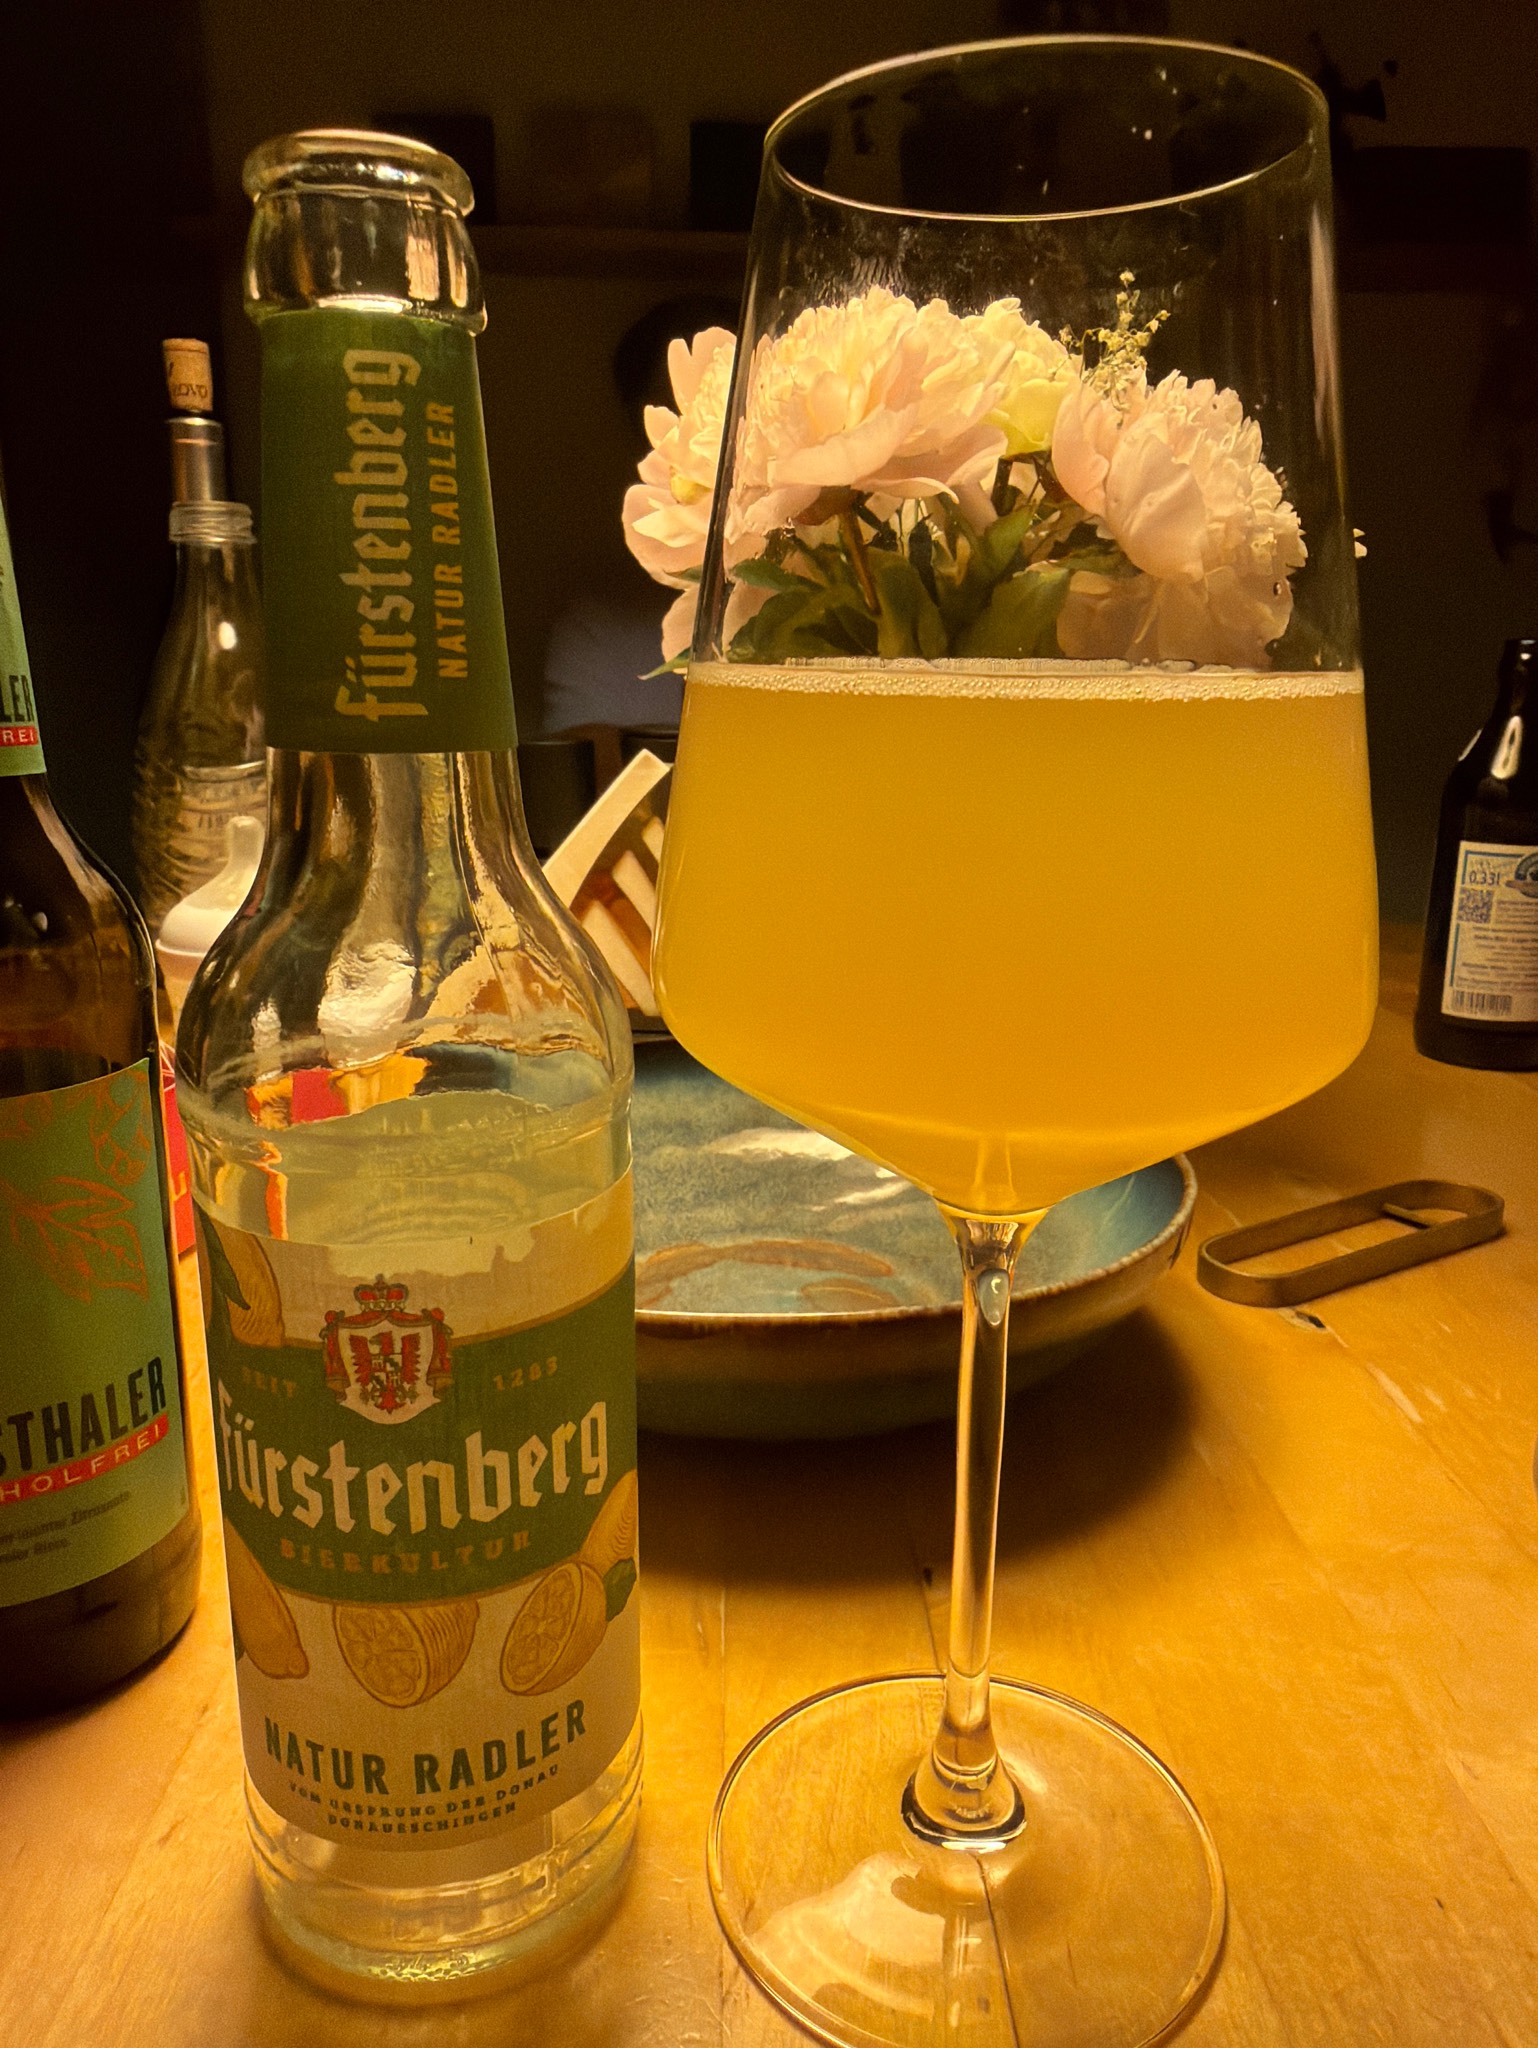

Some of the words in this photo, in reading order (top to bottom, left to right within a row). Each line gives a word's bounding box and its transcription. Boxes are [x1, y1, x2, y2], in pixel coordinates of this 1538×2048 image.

[426, 402, 462, 545] RADLER
[333, 349, 429, 722] fürstenberg
[433, 563, 468, 678] NATUR
[242, 1367, 298, 1399] SEIT
[218, 1378, 608, 1536] fürstenberg
[280, 1530, 531, 1574] BIERKULTUR
[265, 1716, 390, 1796] NATUR
[414, 1699, 586, 1795] RADLER
[289, 1779, 322, 1804] VOM
[329, 1799, 437, 1818] URSPRUNG
[446, 1795, 487, 1814] DER
[496, 1764, 560, 1801] DONAU
[328, 1801, 518, 1834] DONAUESCHINGEN
